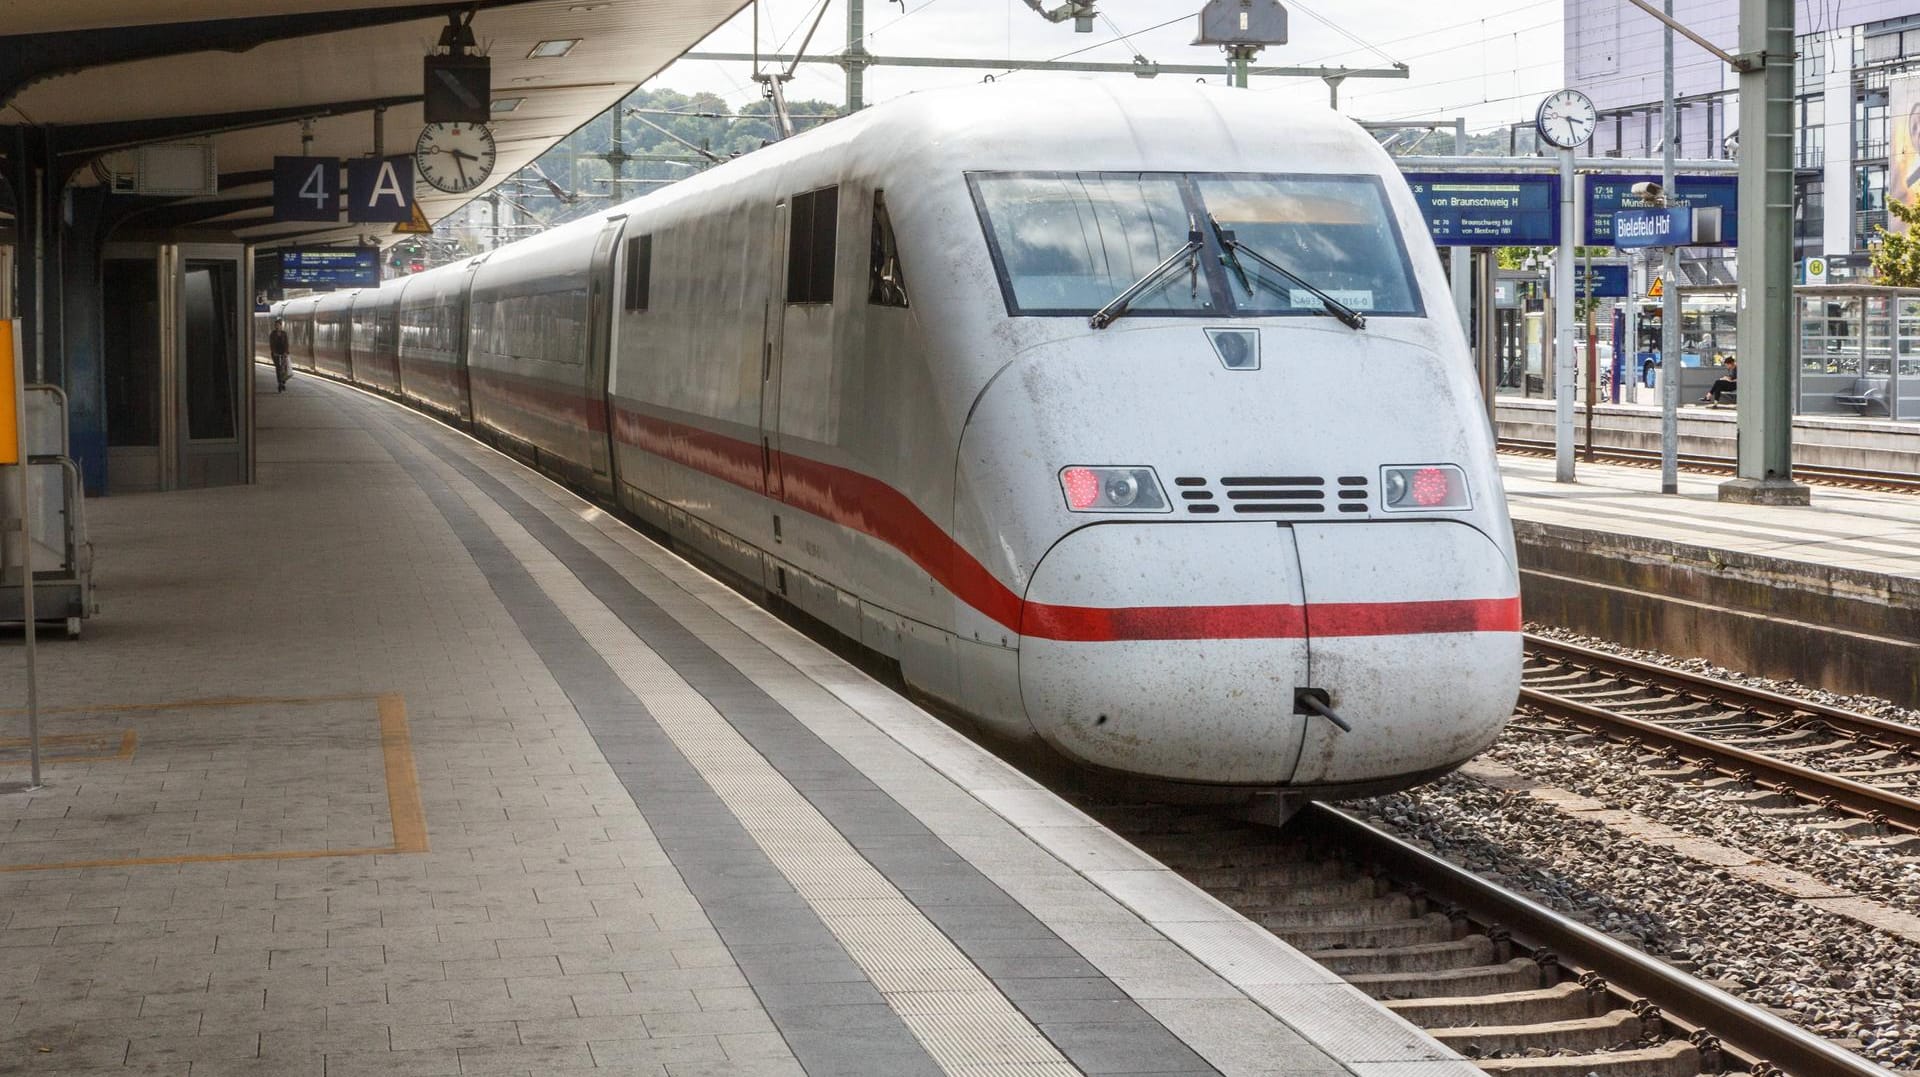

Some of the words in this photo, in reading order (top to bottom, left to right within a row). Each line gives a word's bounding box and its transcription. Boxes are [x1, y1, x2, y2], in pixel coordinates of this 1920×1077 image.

[299, 163, 329, 209] 4
[368, 161, 406, 207] A
[1451, 197, 1509, 208] Braunschweig
[1512, 198, 1519, 206] H
[1461, 218, 1500, 227] Braunschweig
[1617, 216, 1654, 237] Bielefeld
[1655, 214, 1670, 235] Hbf
